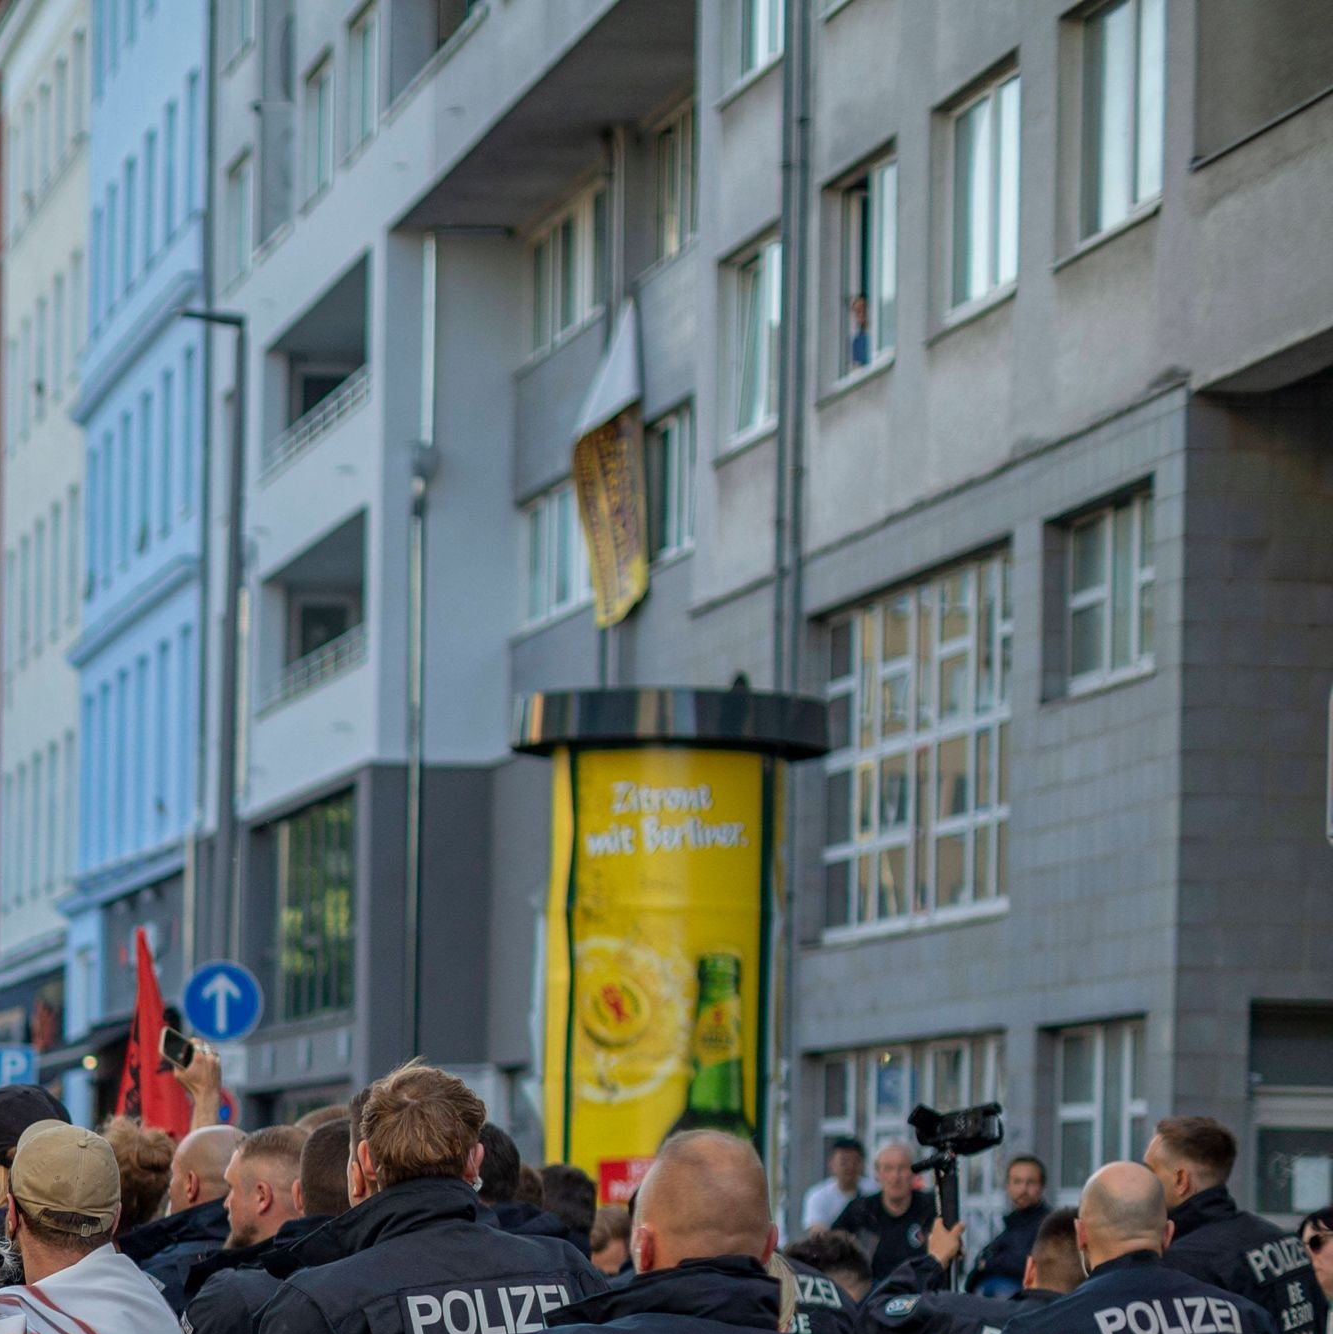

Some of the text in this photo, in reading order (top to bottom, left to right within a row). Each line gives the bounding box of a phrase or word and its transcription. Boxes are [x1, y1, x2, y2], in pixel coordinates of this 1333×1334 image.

[586, 824, 636, 857] mit
[1246, 1237, 1310, 1283] POLIZE
[795, 1274, 843, 1310] IZEI
